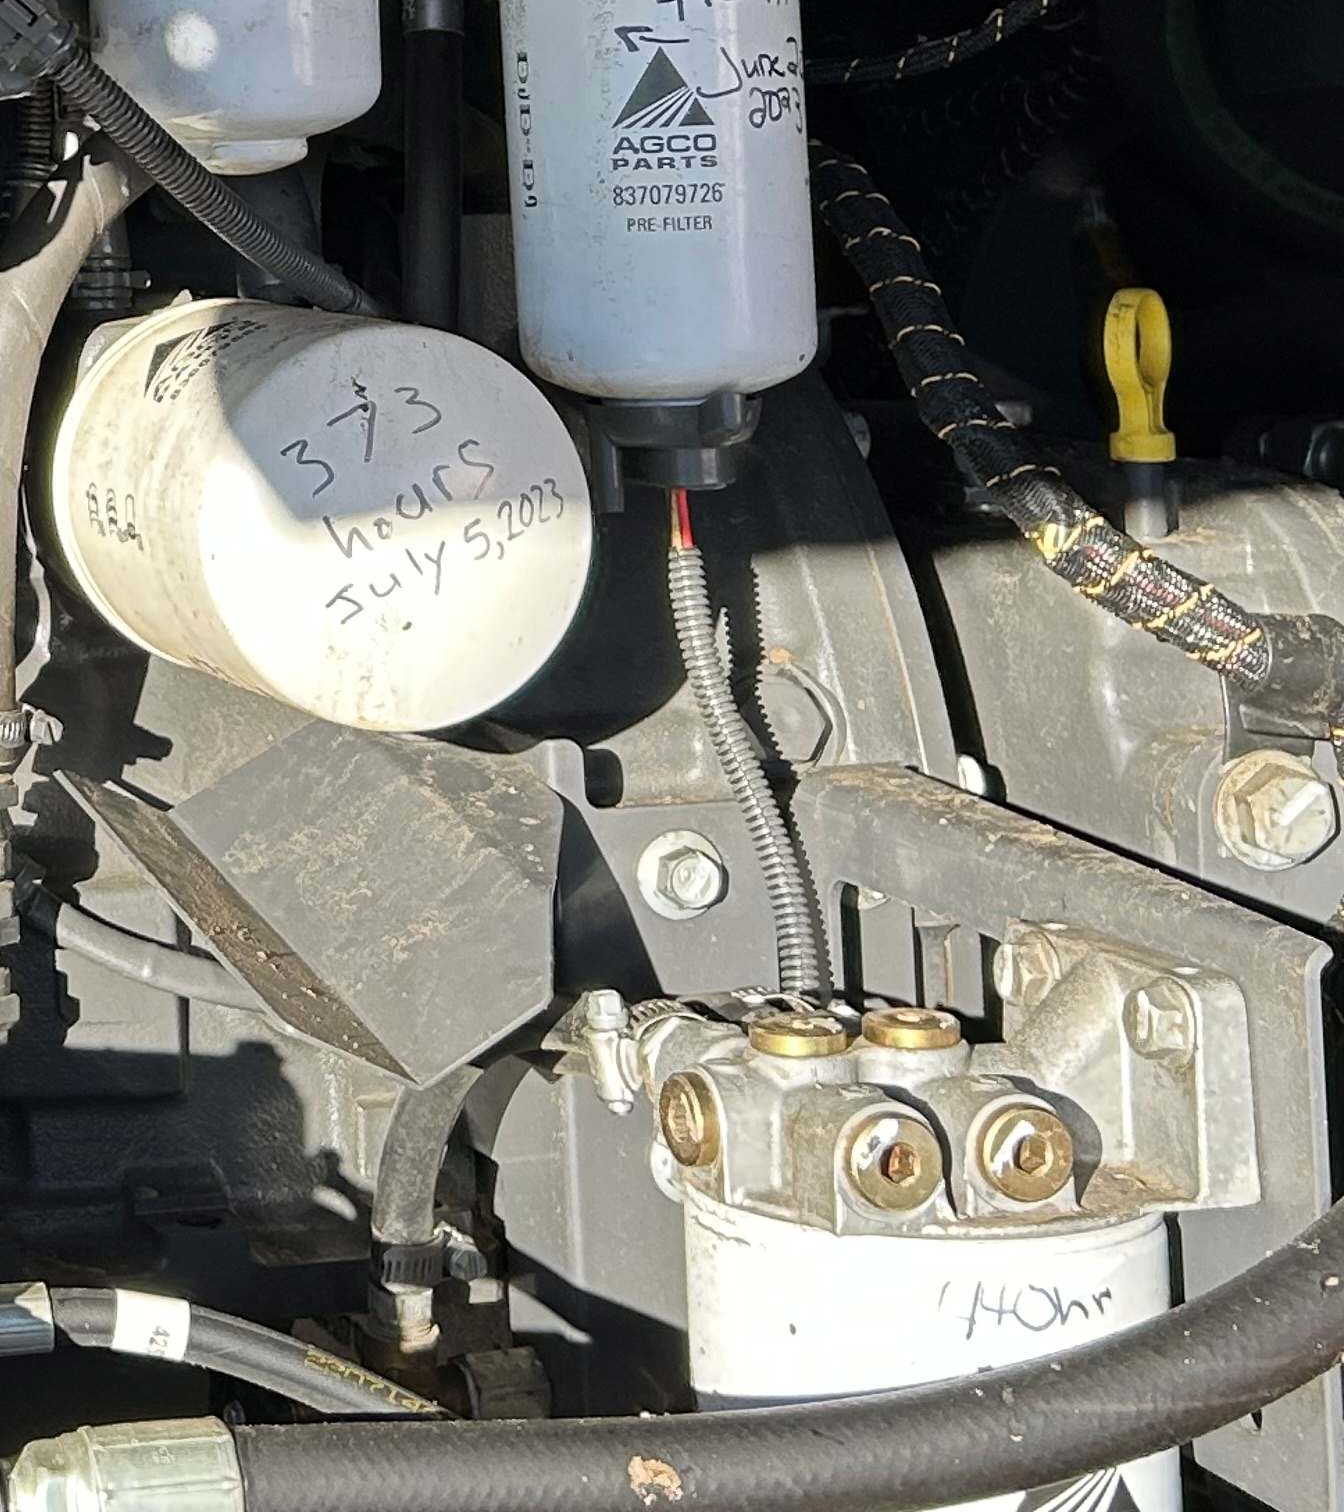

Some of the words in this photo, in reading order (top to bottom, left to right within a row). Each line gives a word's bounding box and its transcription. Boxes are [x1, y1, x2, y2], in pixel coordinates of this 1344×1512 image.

[611, 155, 718, 170] PARTS
[612, 134, 717, 155] AGCO
[612, 182, 726, 206] 837079726
[281, 386, 442, 499] 373
[322, 439, 495, 559] hours
[324, 541, 446, 625] July
